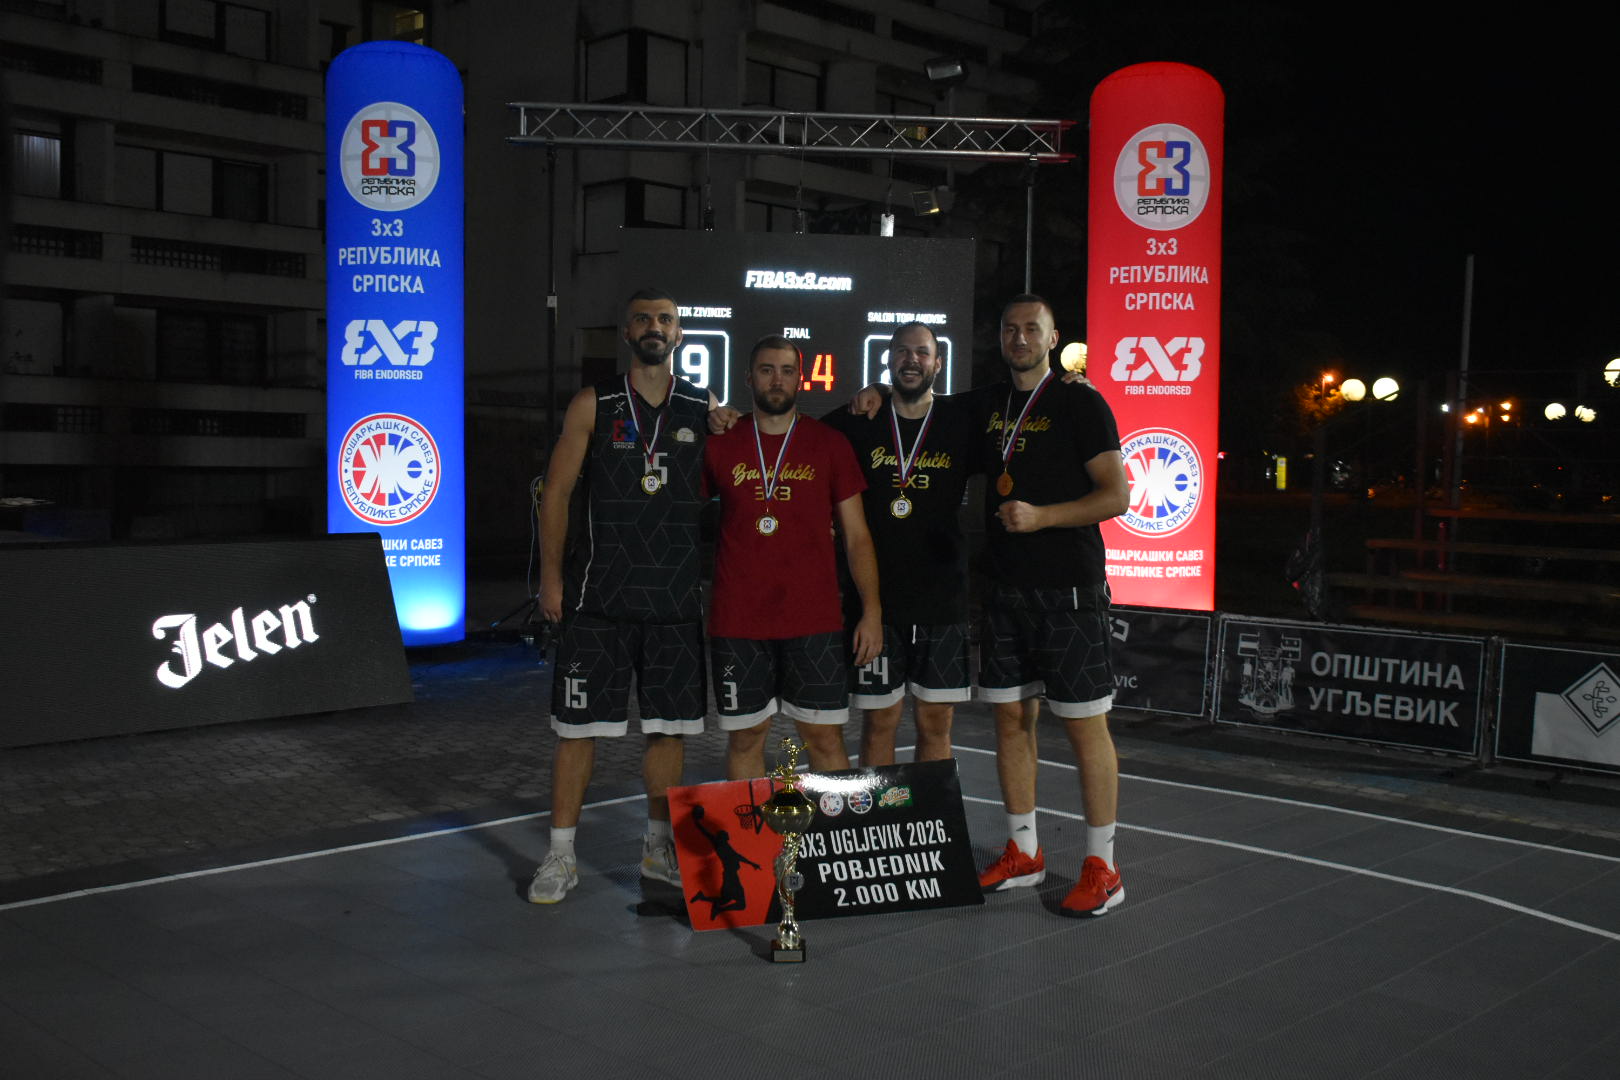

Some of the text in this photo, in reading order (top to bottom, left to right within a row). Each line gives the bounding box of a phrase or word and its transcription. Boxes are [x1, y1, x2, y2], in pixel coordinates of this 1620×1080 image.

[362, 186, 415, 196] СРПСКА
[1138, 206, 1189, 215] СРПСКА
[371, 218, 404, 237] 3x3
[1146, 238, 1178, 255] 3x3
[338, 247, 441, 268] РЕПУБЛИКА
[352, 275, 425, 293] СРПСКА
[745, 271, 852, 291] FIBA3x3.com
[1109, 265, 1209, 284] РЕПУБЛИКА
[1125, 293, 1195, 311] СРПСКА
[867, 312, 895, 323] SALON
[783, 327, 811, 339] FINAL
[354, 369, 423, 381] FIBA ENDORSED
[671, 344, 710, 389] 9
[1125, 385, 1192, 396] FIBA ENDORSED
[344, 421, 434, 464] КОШАРКАШКИ САВЕЗ
[1120, 435, 1198, 478] ШАРКАШКИ САВЕЗ
[344, 479, 434, 518] РЕПУБЛИКЕ СРПСКЕ
[1166, 493, 1198, 530] СРПСКЕ
[411, 539, 443, 550] САВЕЗ
[400, 556, 441, 567] СРПСКЕ
[1105, 549, 1204, 562] ОШАРКАШКИ САВЕЗ
[1166, 565, 1202, 577] СРПСКЕ
[152, 600, 320, 689] Jelen
[858, 656, 889, 685] 24
[1311, 652, 1465, 690] ОПШТИНА
[564, 676, 588, 709] 15
[723, 681, 738, 711] 3
[1308, 686, 1460, 728] УГЉЕВИК
[799, 818, 952, 859] 3X3 UGLJEVIK 2026.
[818, 850, 945, 884] POBJEDNIK
[833, 877, 942, 908] 2.000 KM
